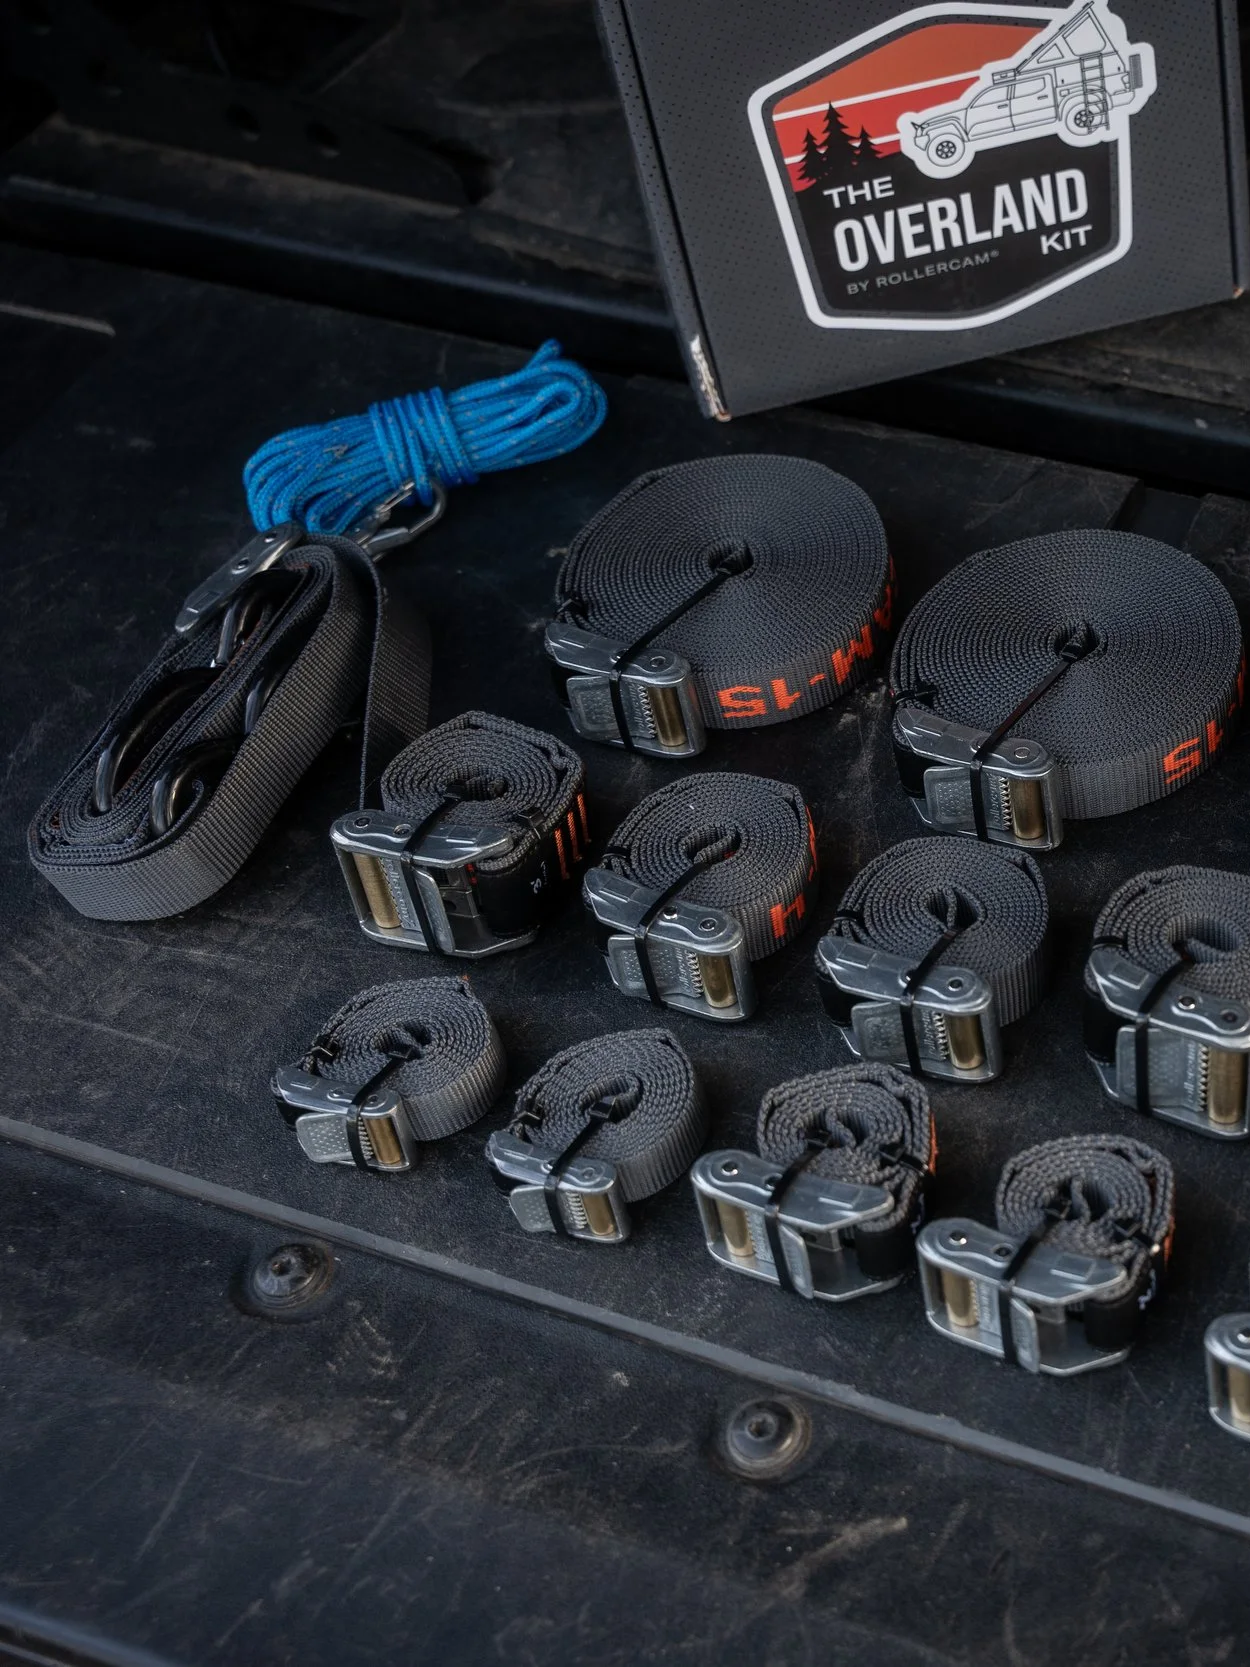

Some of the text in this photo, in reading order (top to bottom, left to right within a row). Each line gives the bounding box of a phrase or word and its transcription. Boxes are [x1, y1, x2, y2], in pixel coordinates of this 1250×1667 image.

[824, 175, 895, 208] THE
[833, 168, 1089, 272] OVERLAND
[1040, 224, 1093, 255] KIT
[846, 281, 870, 295] BY
